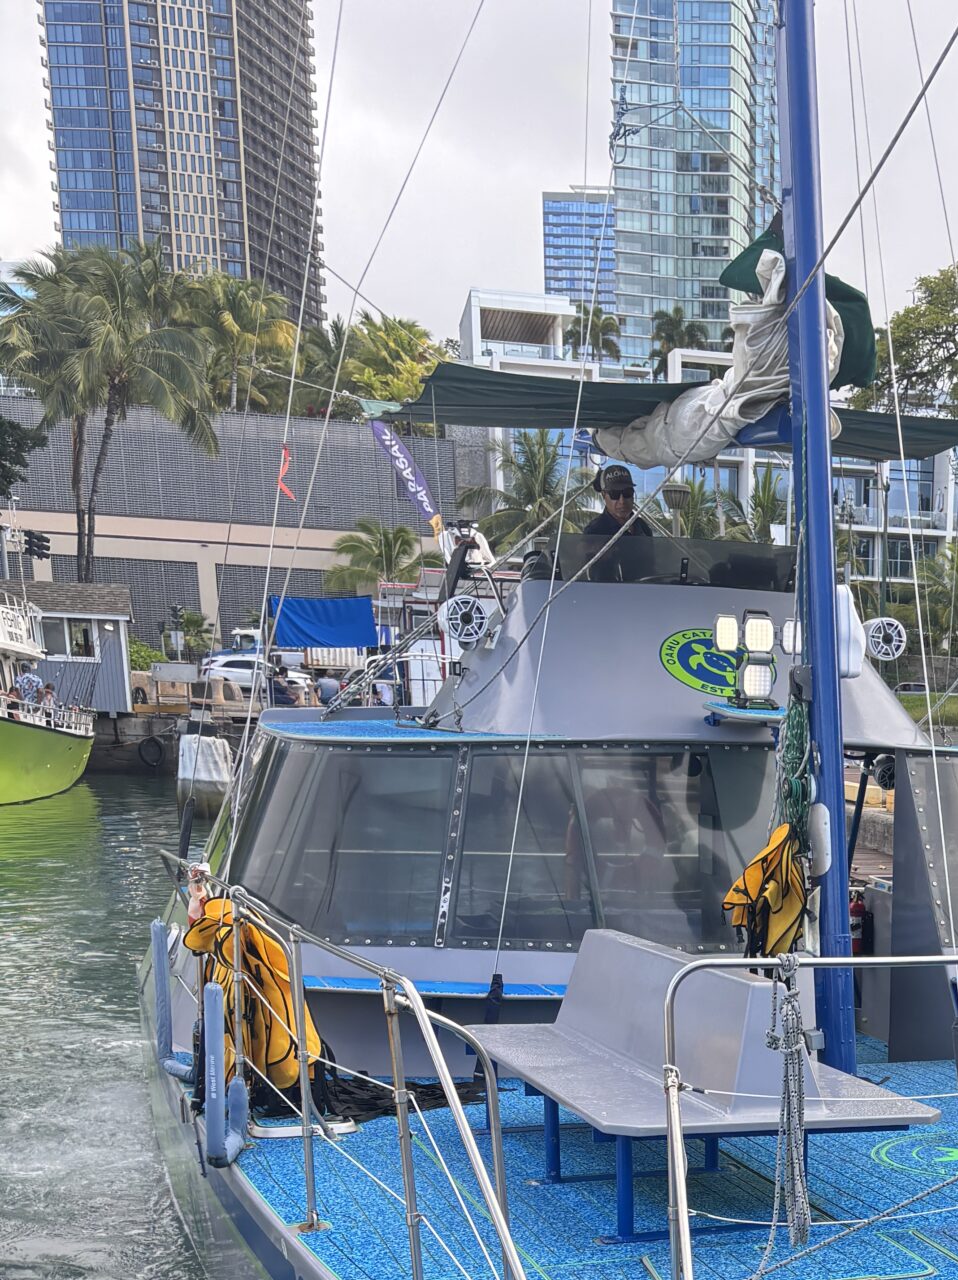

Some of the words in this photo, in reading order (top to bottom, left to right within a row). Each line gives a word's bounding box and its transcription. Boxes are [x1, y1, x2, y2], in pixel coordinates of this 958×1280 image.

[381, 428, 434, 514] PARASAIL
[664, 639, 680, 666] OAHU
[700, 683, 726, 694] EST
